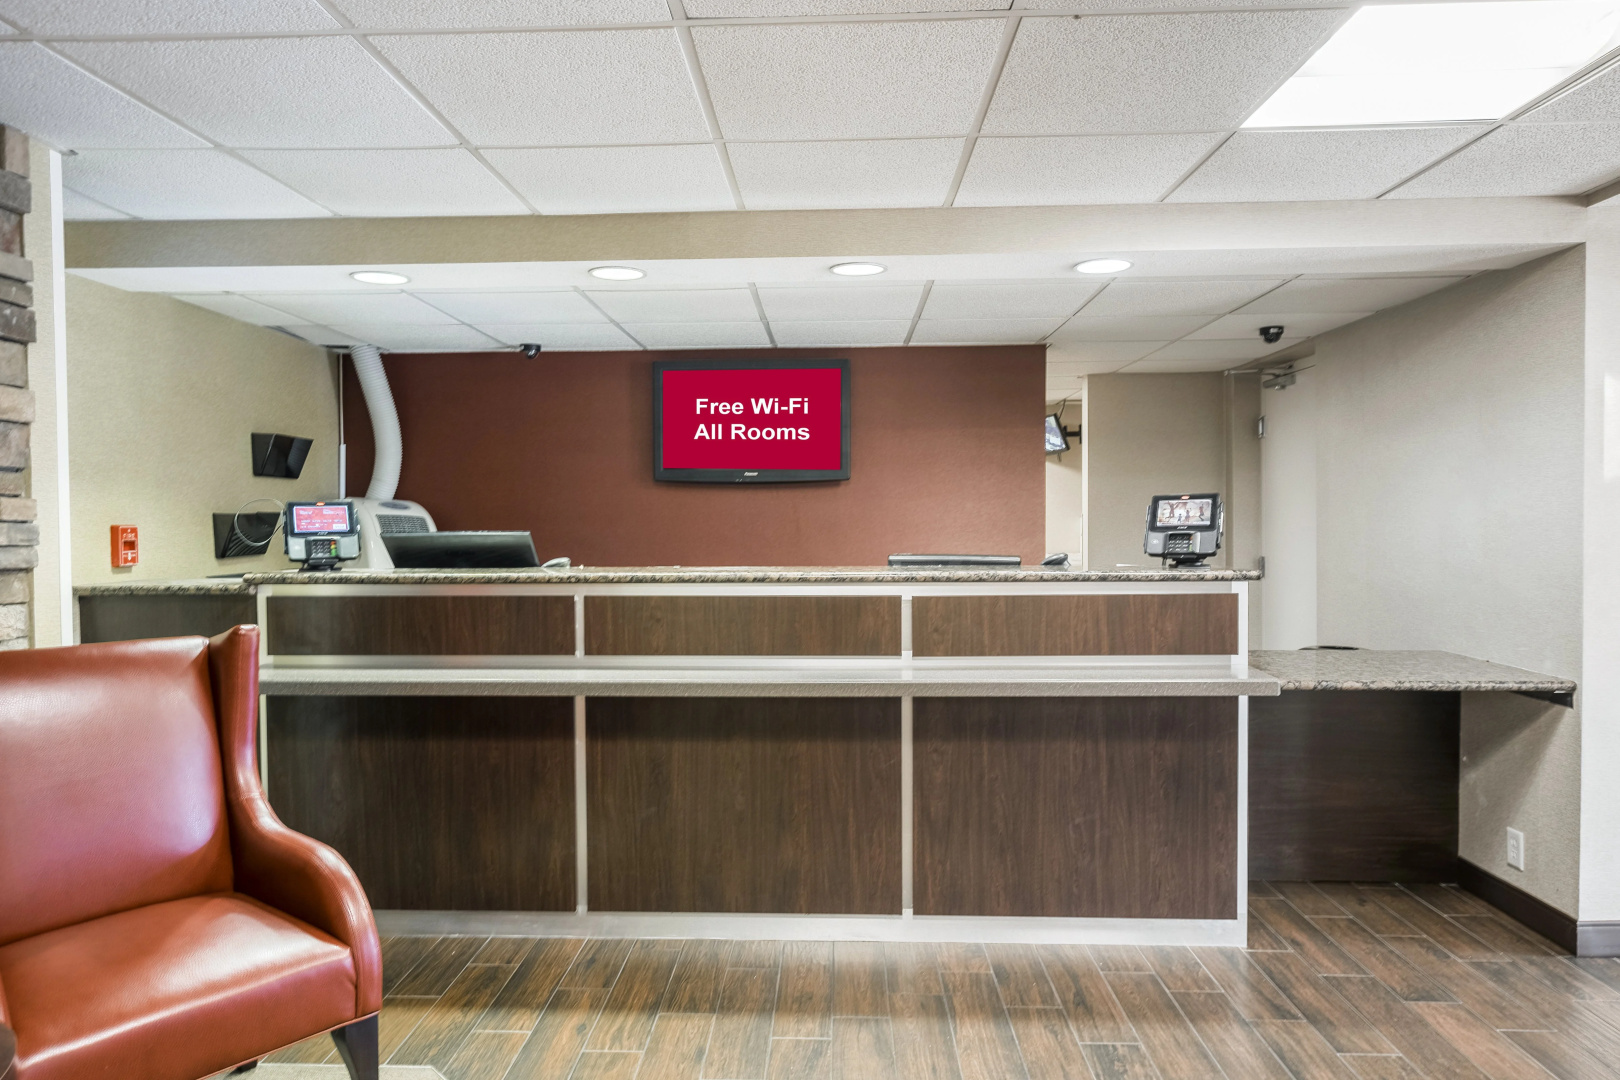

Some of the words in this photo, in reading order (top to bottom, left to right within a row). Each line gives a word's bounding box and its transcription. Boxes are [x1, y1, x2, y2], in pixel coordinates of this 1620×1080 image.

[695, 398, 744, 415] Free
[750, 397, 809, 415] Wi-Fi
[693, 423, 723, 441] All
[730, 423, 811, 441] Rooms
